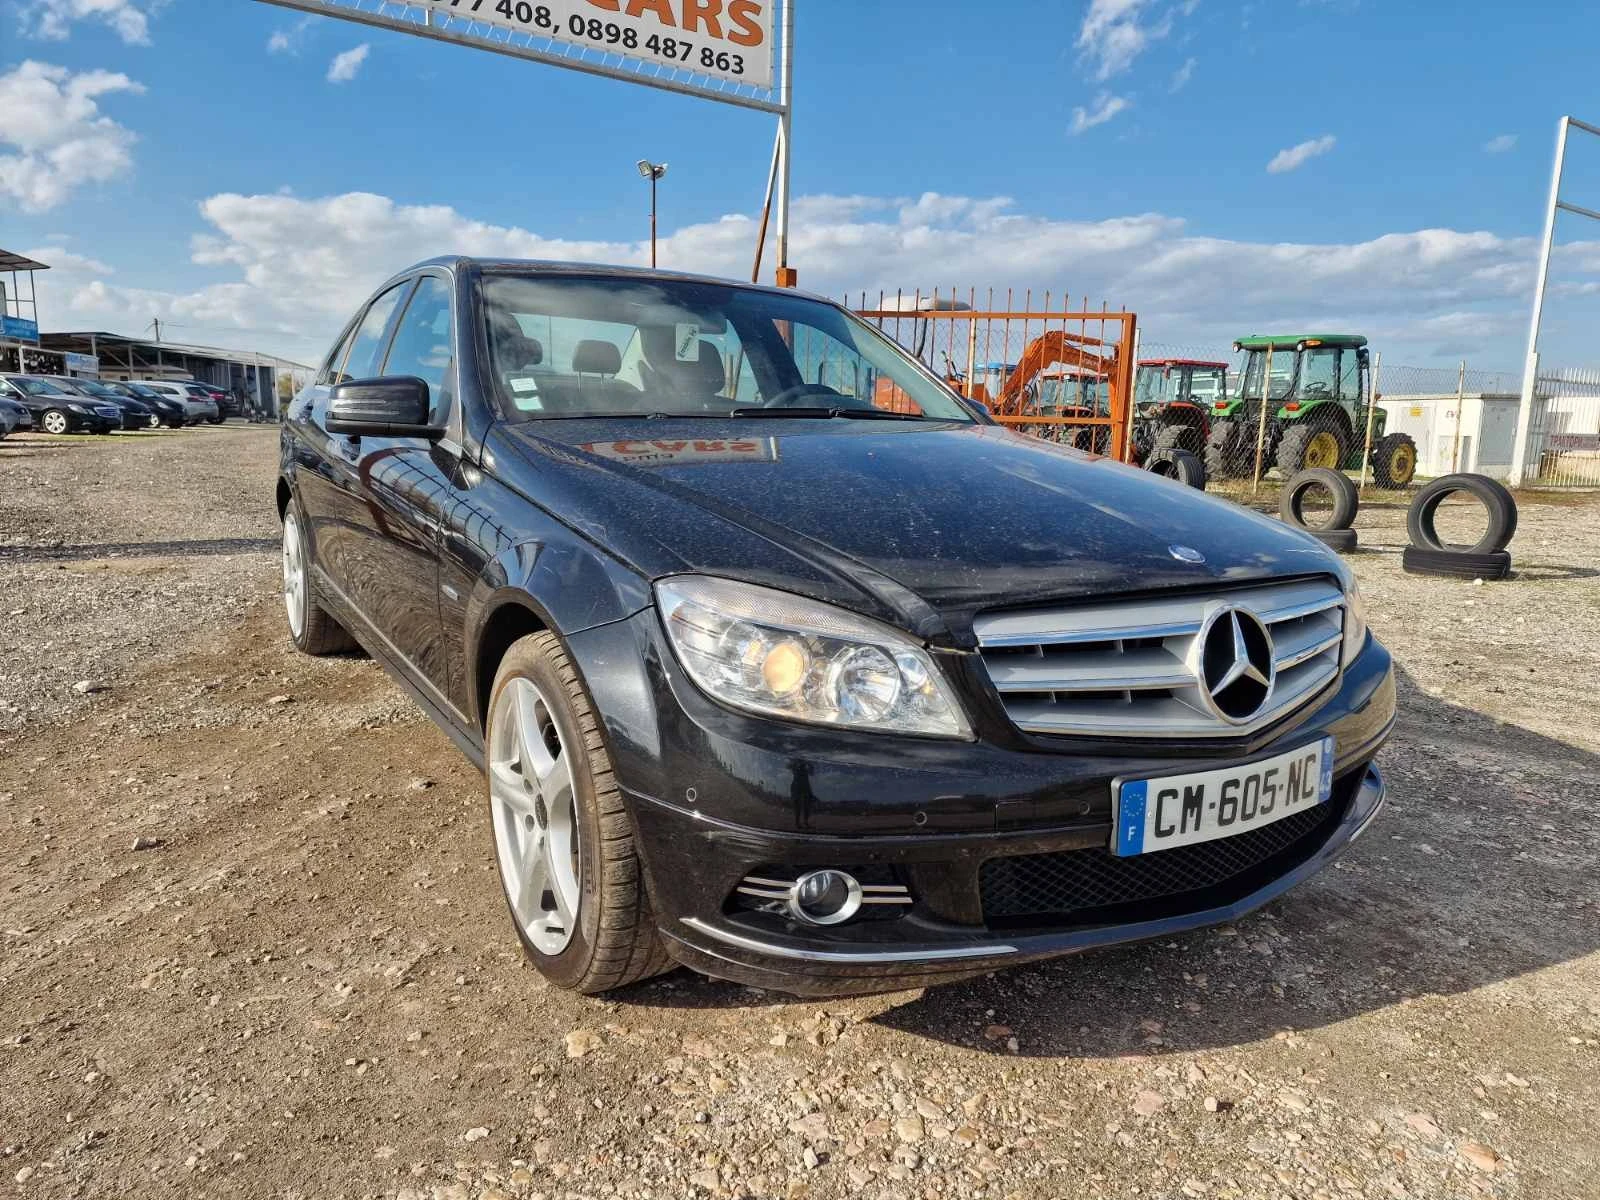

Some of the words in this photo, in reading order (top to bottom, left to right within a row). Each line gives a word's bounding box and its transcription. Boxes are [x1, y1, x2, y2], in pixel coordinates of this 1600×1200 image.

[568, 14, 638, 49] 0898
[645, 34, 693, 62] 487
[701, 47, 744, 75] 863
[585, 0, 764, 47] ARS
[1127, 825, 1137, 842] F
